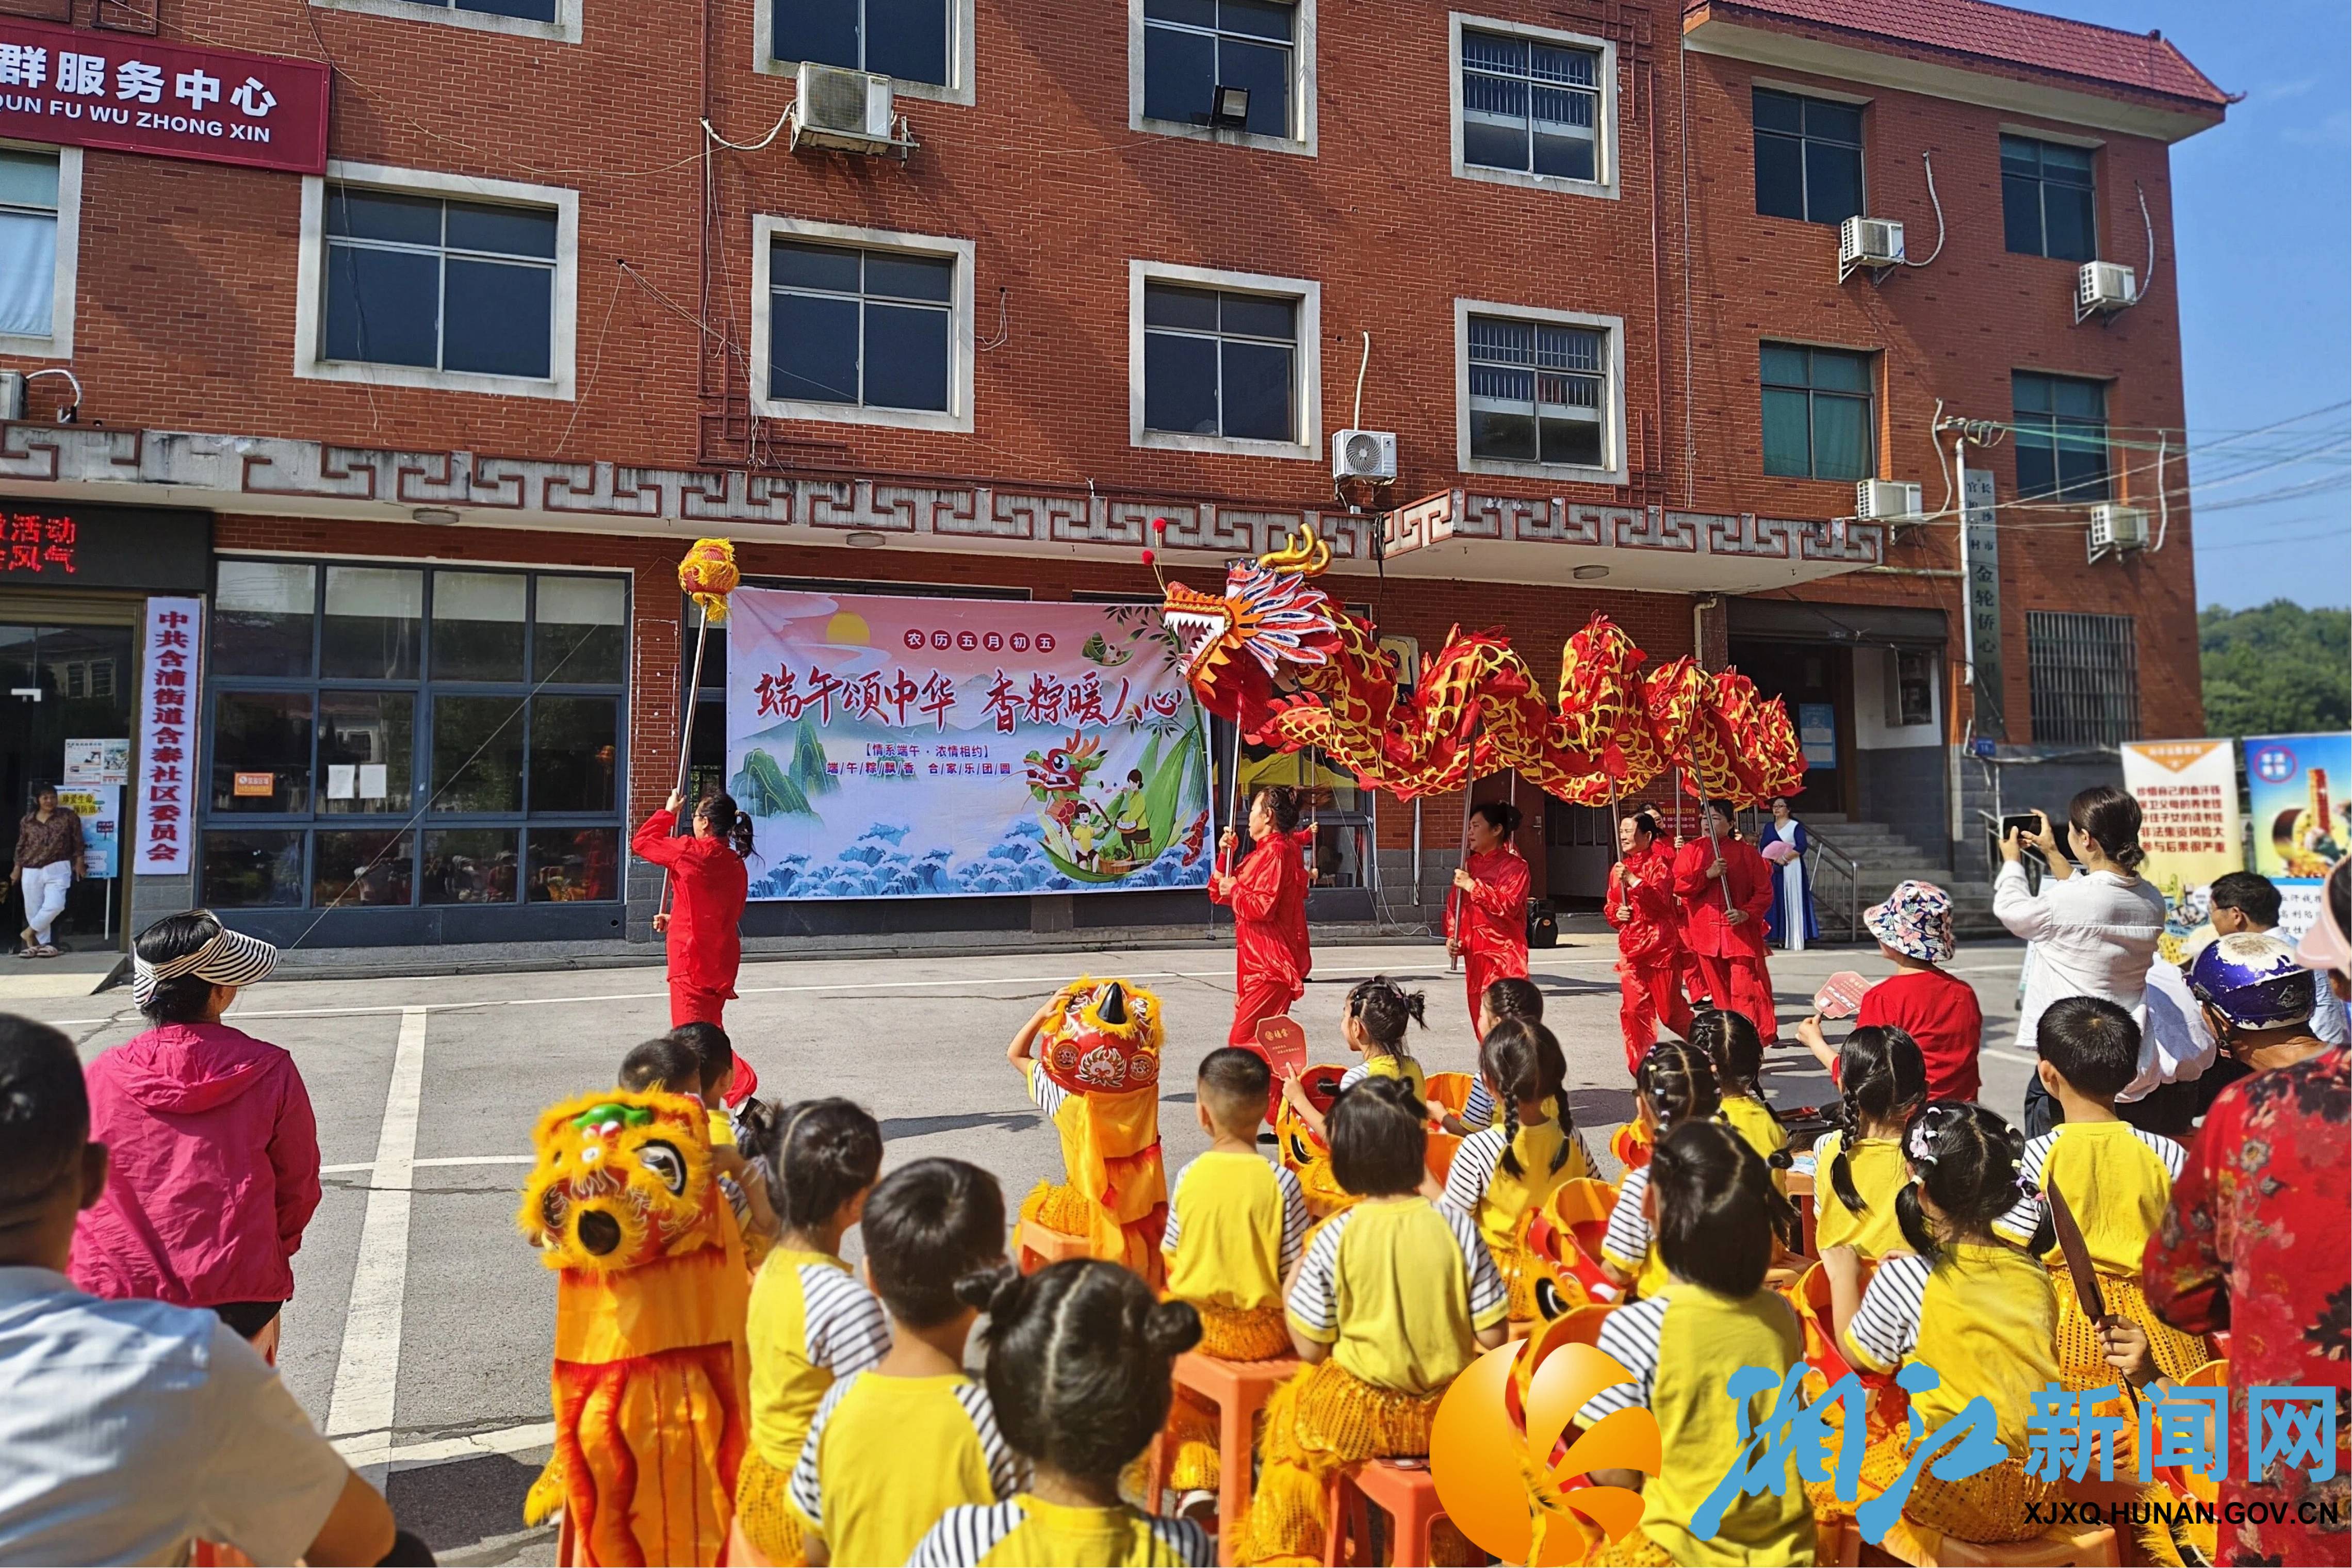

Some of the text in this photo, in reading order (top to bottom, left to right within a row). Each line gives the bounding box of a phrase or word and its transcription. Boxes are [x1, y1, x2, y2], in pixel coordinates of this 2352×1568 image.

[0, 43, 277, 117] 群服务中心
[0, 94, 269, 142] UN FU WU ZHONG XIN
[0, 512, 76, 544] 活动
[0, 545, 75, 572] 风气
[907, 632, 1052, 649] 农历五月初五
[754, 662, 1182, 732] 端午颂中华 香粽暖人心
[146, 611, 189, 861] 中共含浦街道含泰社区委员会
[2141, 826, 2225, 838] 非法集资风险大
[2142, 841, 2226, 853] 参与后果很严重
